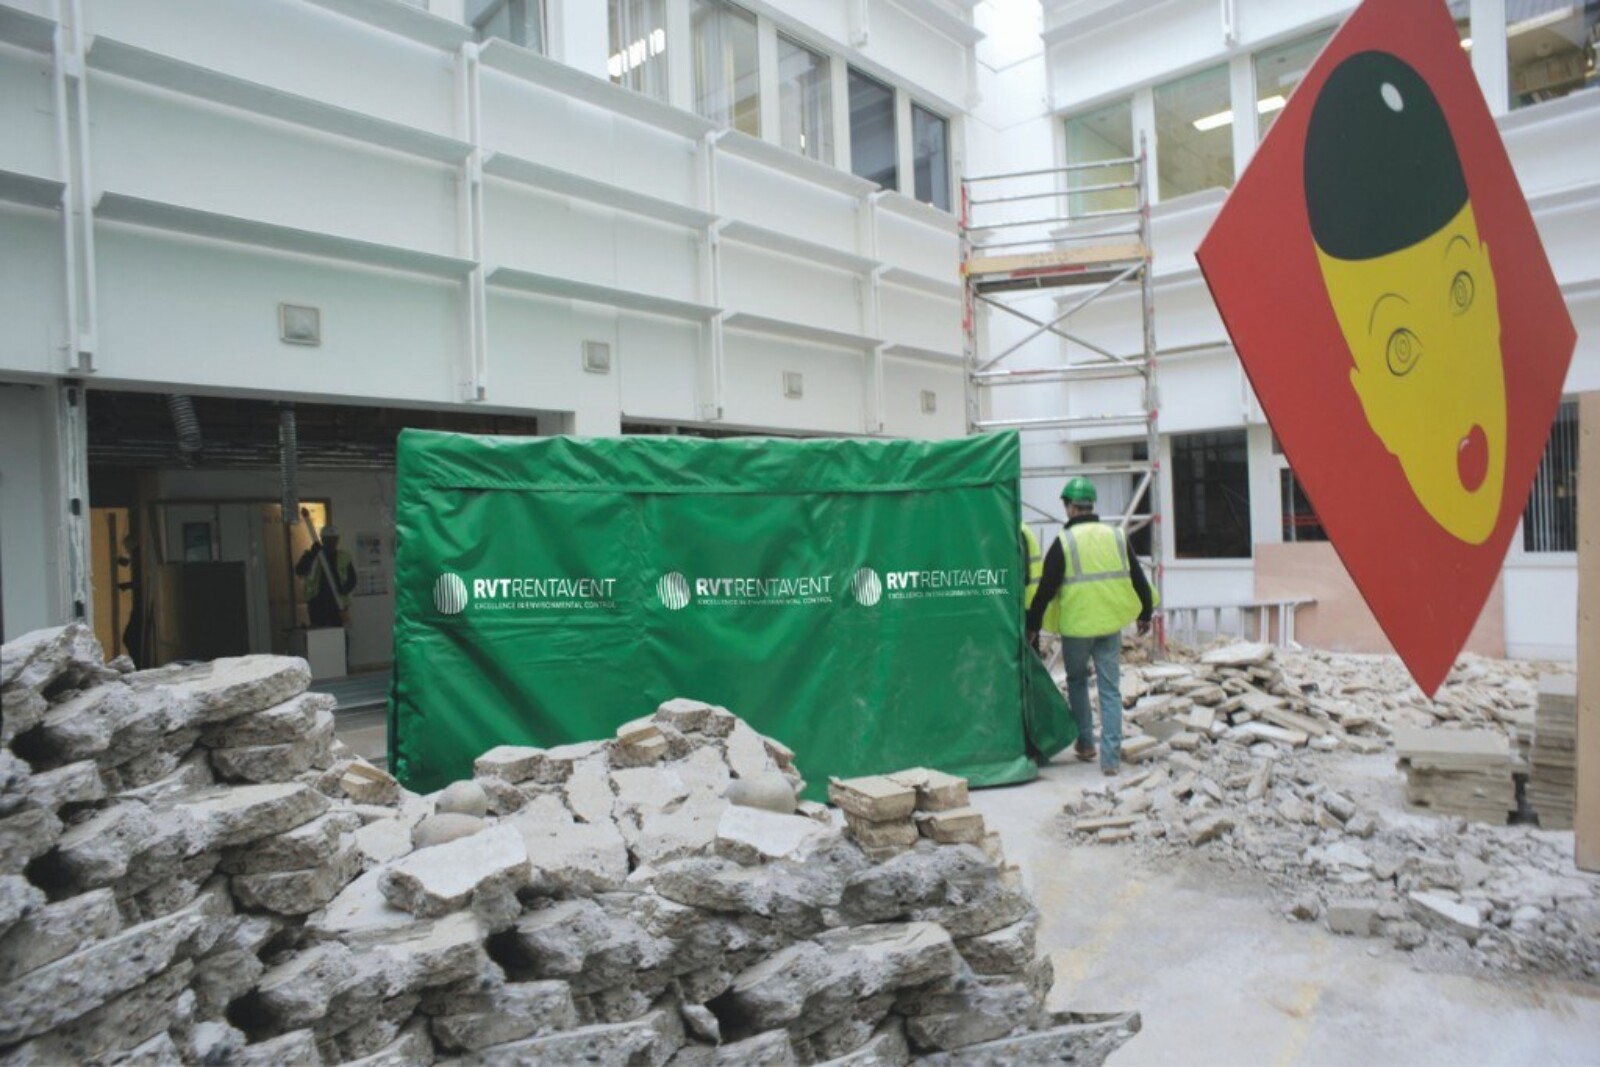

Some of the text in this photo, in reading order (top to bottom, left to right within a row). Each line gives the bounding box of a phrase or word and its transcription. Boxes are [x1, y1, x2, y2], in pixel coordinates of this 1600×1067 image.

[473, 578, 616, 598] RVTRENTAVENT
[696, 575, 833, 597] RVTRENTAVENT
[886, 569, 1008, 590] RVTRENTAVENT
